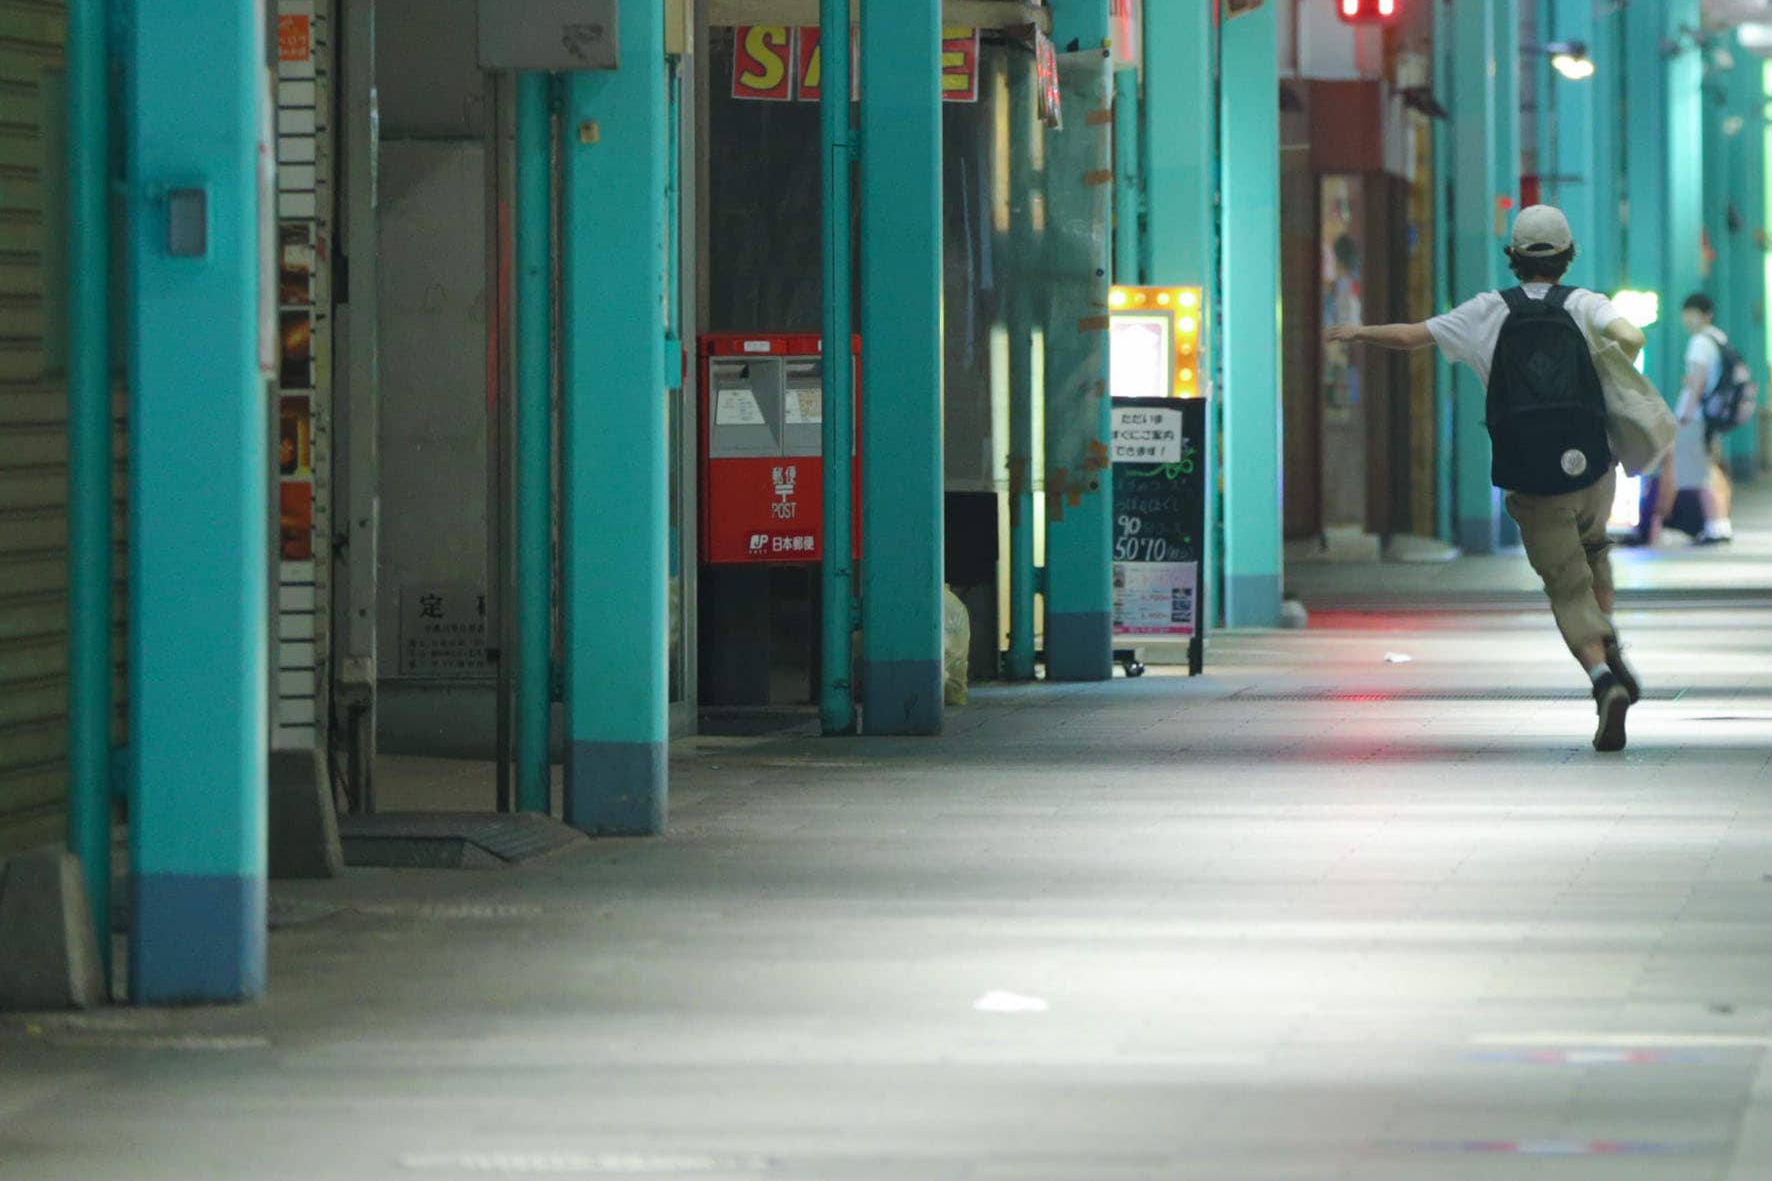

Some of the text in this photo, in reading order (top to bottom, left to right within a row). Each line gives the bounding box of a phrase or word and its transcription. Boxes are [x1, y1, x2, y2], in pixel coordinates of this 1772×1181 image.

[740, 25, 970, 91] SE
[772, 466, 797, 485] 郵便
[771, 502, 797, 519] POST
[773, 536, 815, 551] 日本郵便
